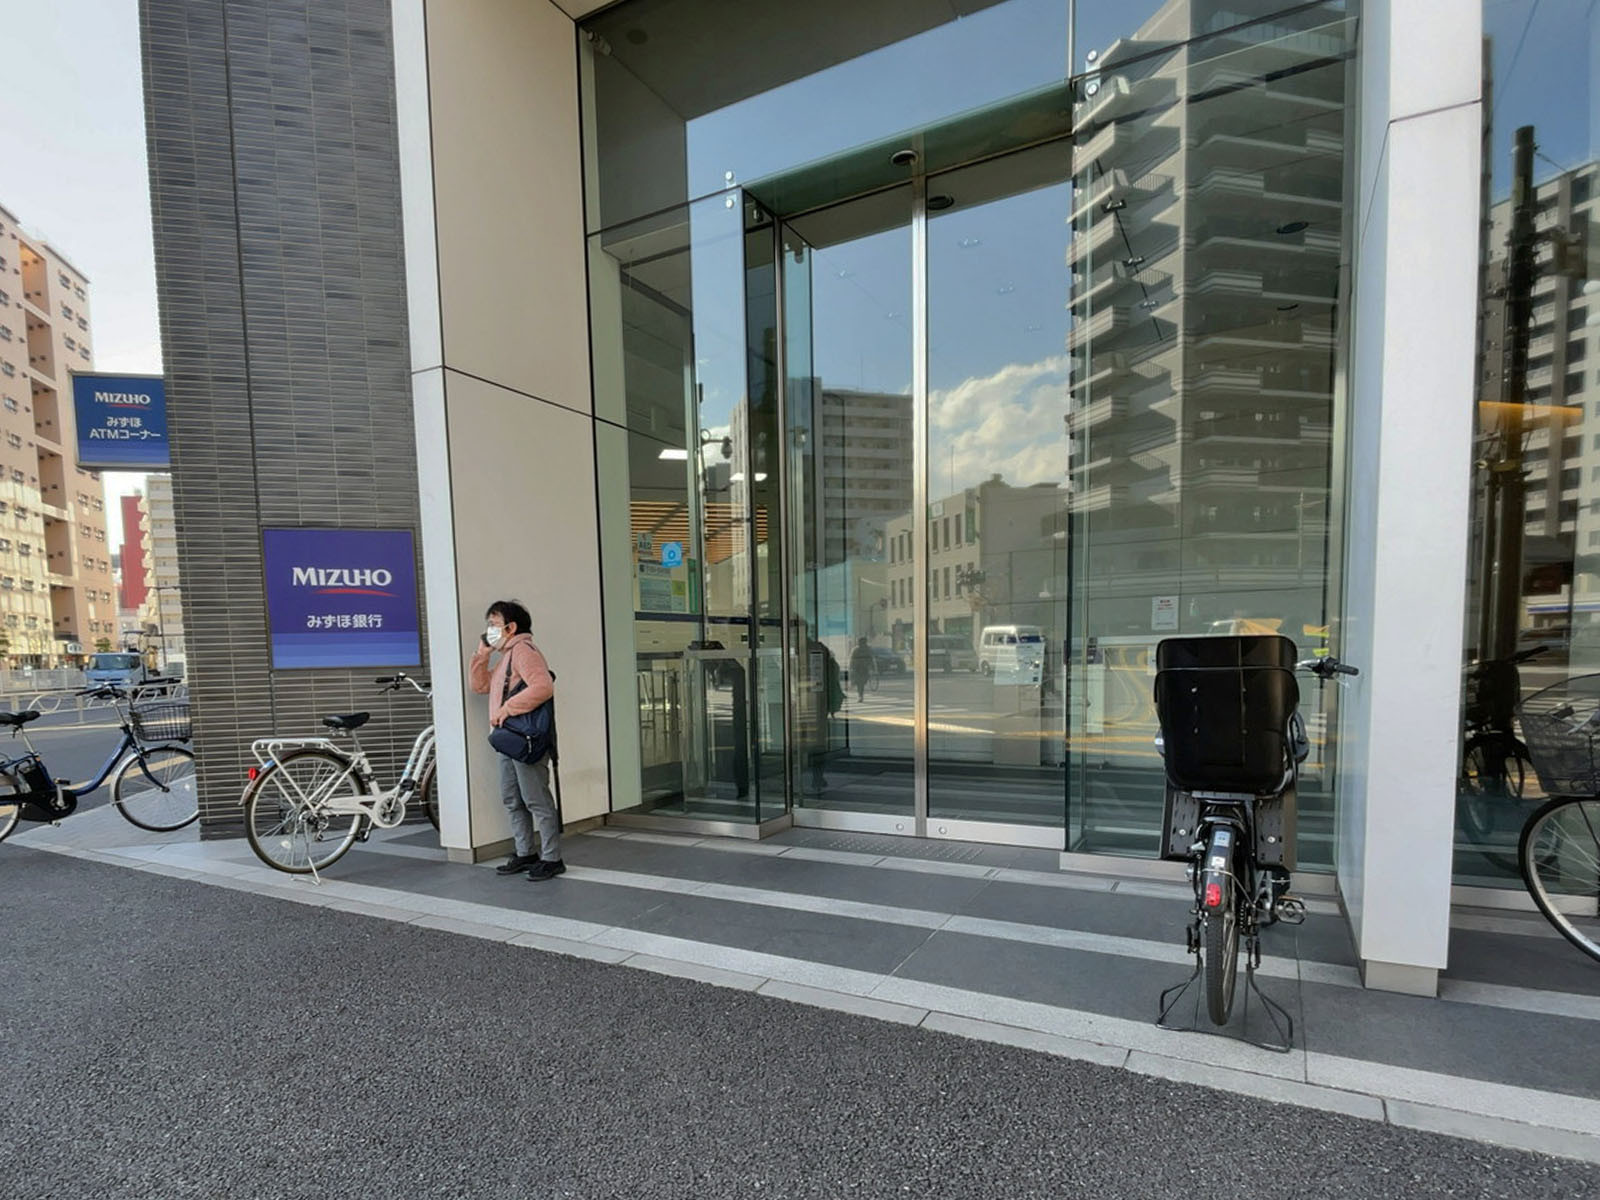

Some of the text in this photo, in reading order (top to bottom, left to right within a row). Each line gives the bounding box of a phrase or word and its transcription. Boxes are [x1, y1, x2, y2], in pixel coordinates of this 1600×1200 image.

[95, 391, 151, 405] MIZUHO
[106, 416, 143, 428] みずほ
[89, 428, 161, 440] ATMコーナー
[292, 567, 392, 586] MIZUHO
[306, 614, 383, 628] みずほ銀行
